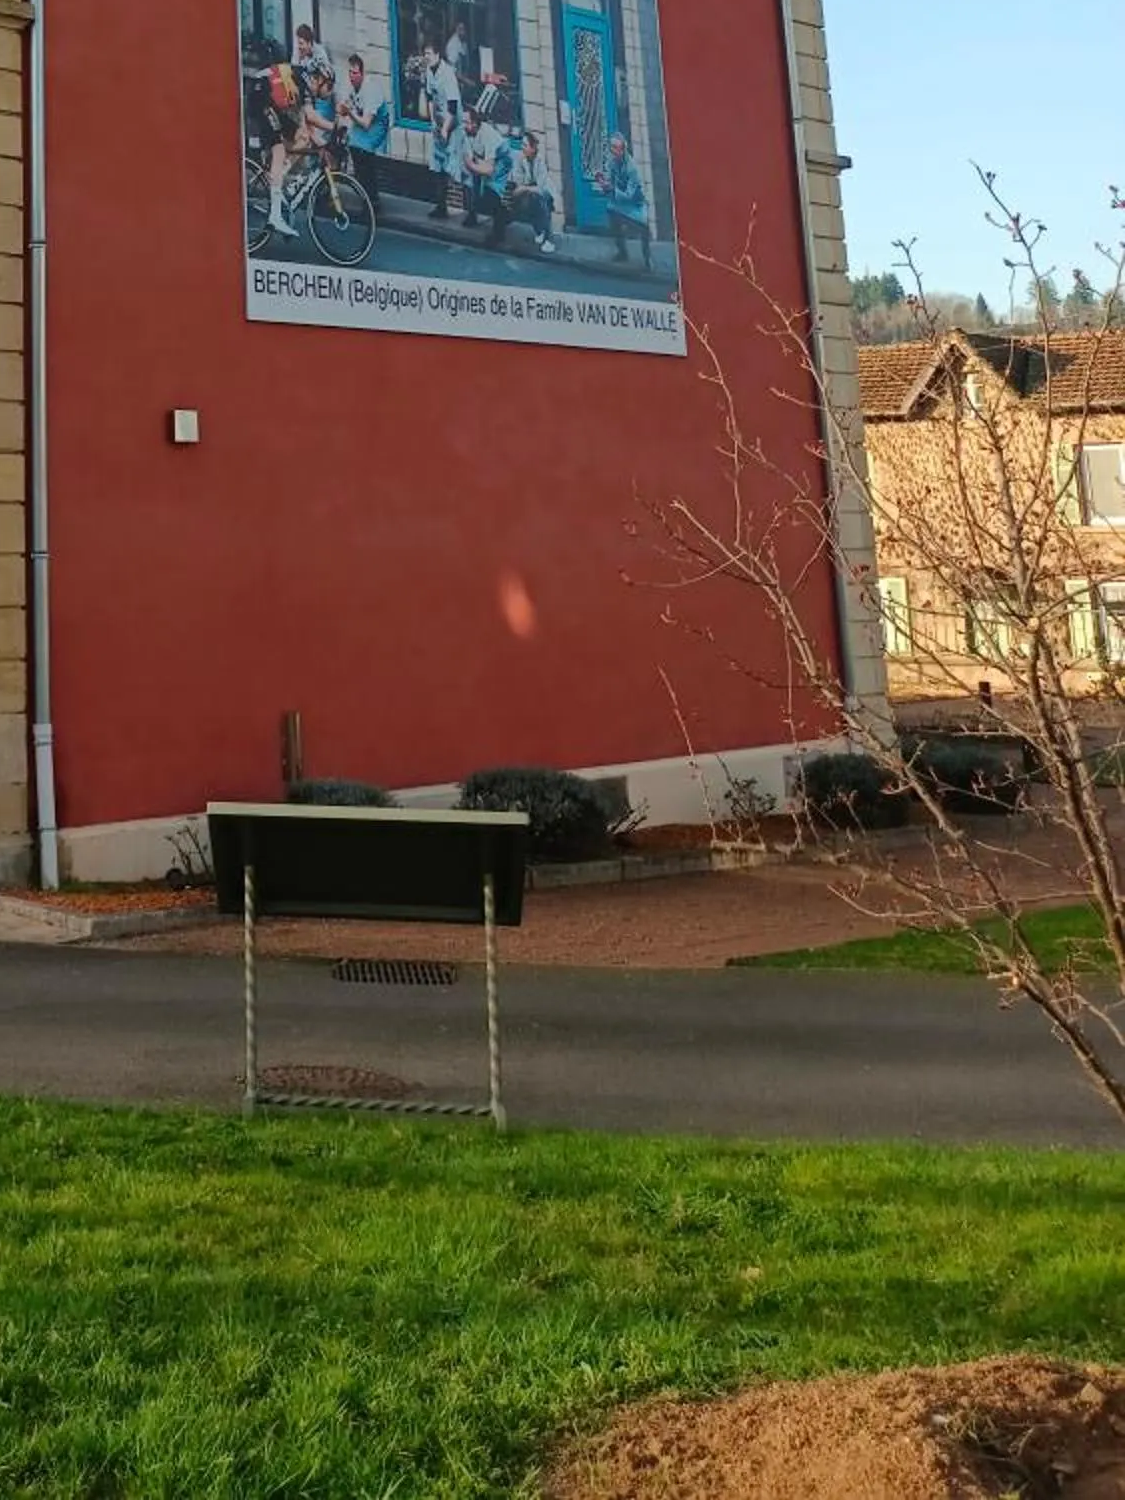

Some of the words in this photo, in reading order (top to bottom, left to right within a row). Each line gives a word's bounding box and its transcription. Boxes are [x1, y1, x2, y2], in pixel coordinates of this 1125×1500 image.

[254, 269, 343, 301] BERCHEM
[349, 279, 423, 314] (Belgique)
[427, 287, 486, 317] Origines
[490, 293, 507, 316] de
[510, 295, 523, 319] la
[526, 297, 573, 323] Famille
[576, 301, 606, 325] VAN
[609, 305, 628, 327] DE
[630, 307, 678, 333] WALLE
